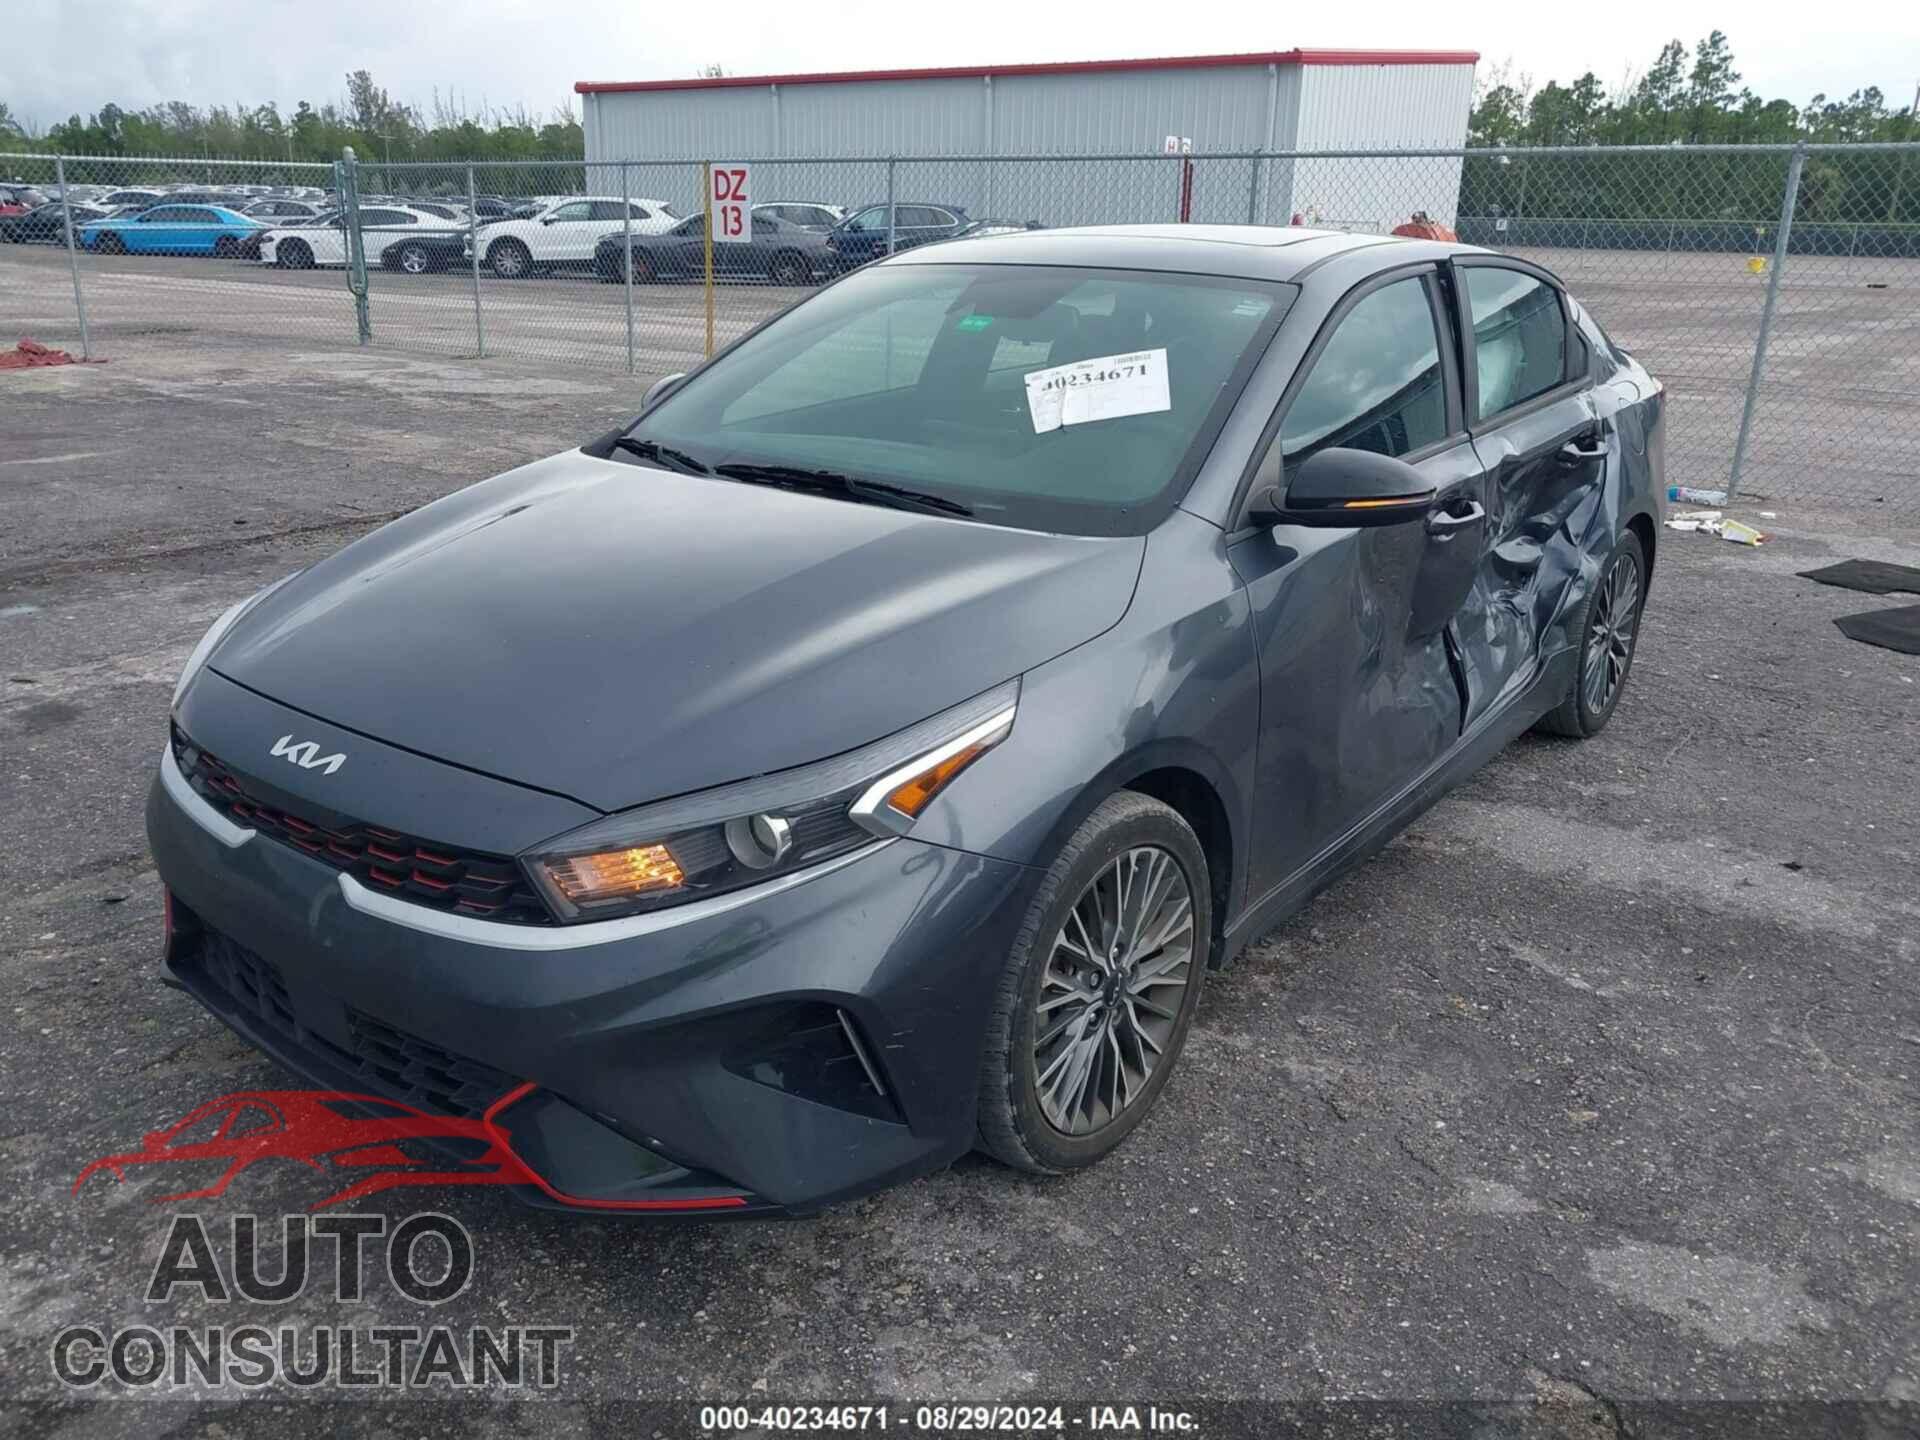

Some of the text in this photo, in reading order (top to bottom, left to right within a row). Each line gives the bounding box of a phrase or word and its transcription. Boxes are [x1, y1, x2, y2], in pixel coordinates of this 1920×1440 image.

[714, 169, 747, 201] DZ
[721, 205, 743, 236] 13
[1041, 364, 1148, 392] 40234671
[269, 734, 347, 776] KIA
